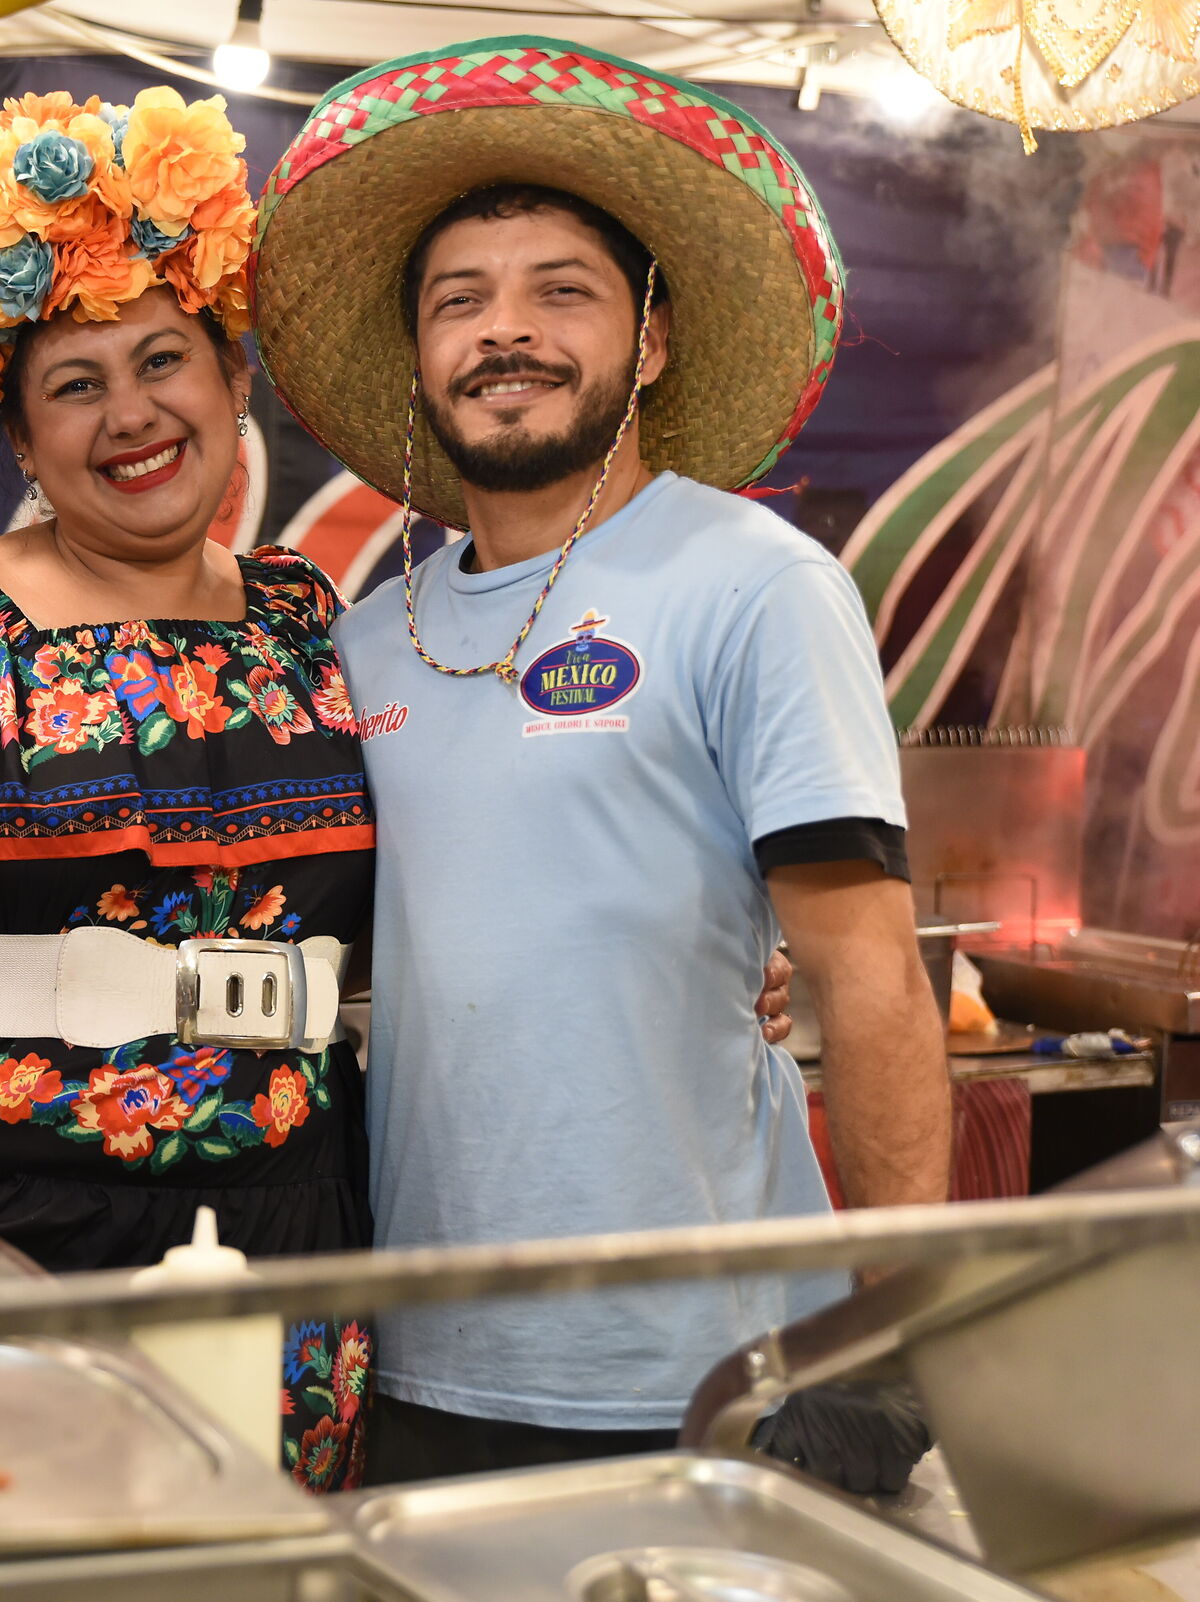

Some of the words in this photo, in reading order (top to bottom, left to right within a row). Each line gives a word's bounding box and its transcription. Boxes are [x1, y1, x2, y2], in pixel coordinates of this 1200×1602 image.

[566, 650, 591, 665] Viva
[541, 663, 617, 692] MEXICO
[550, 688, 596, 706] FESTIVAL
[554, 719, 582, 730] COLORI
[585, 719, 590, 729] E
[593, 718, 626, 729] SAPORI
